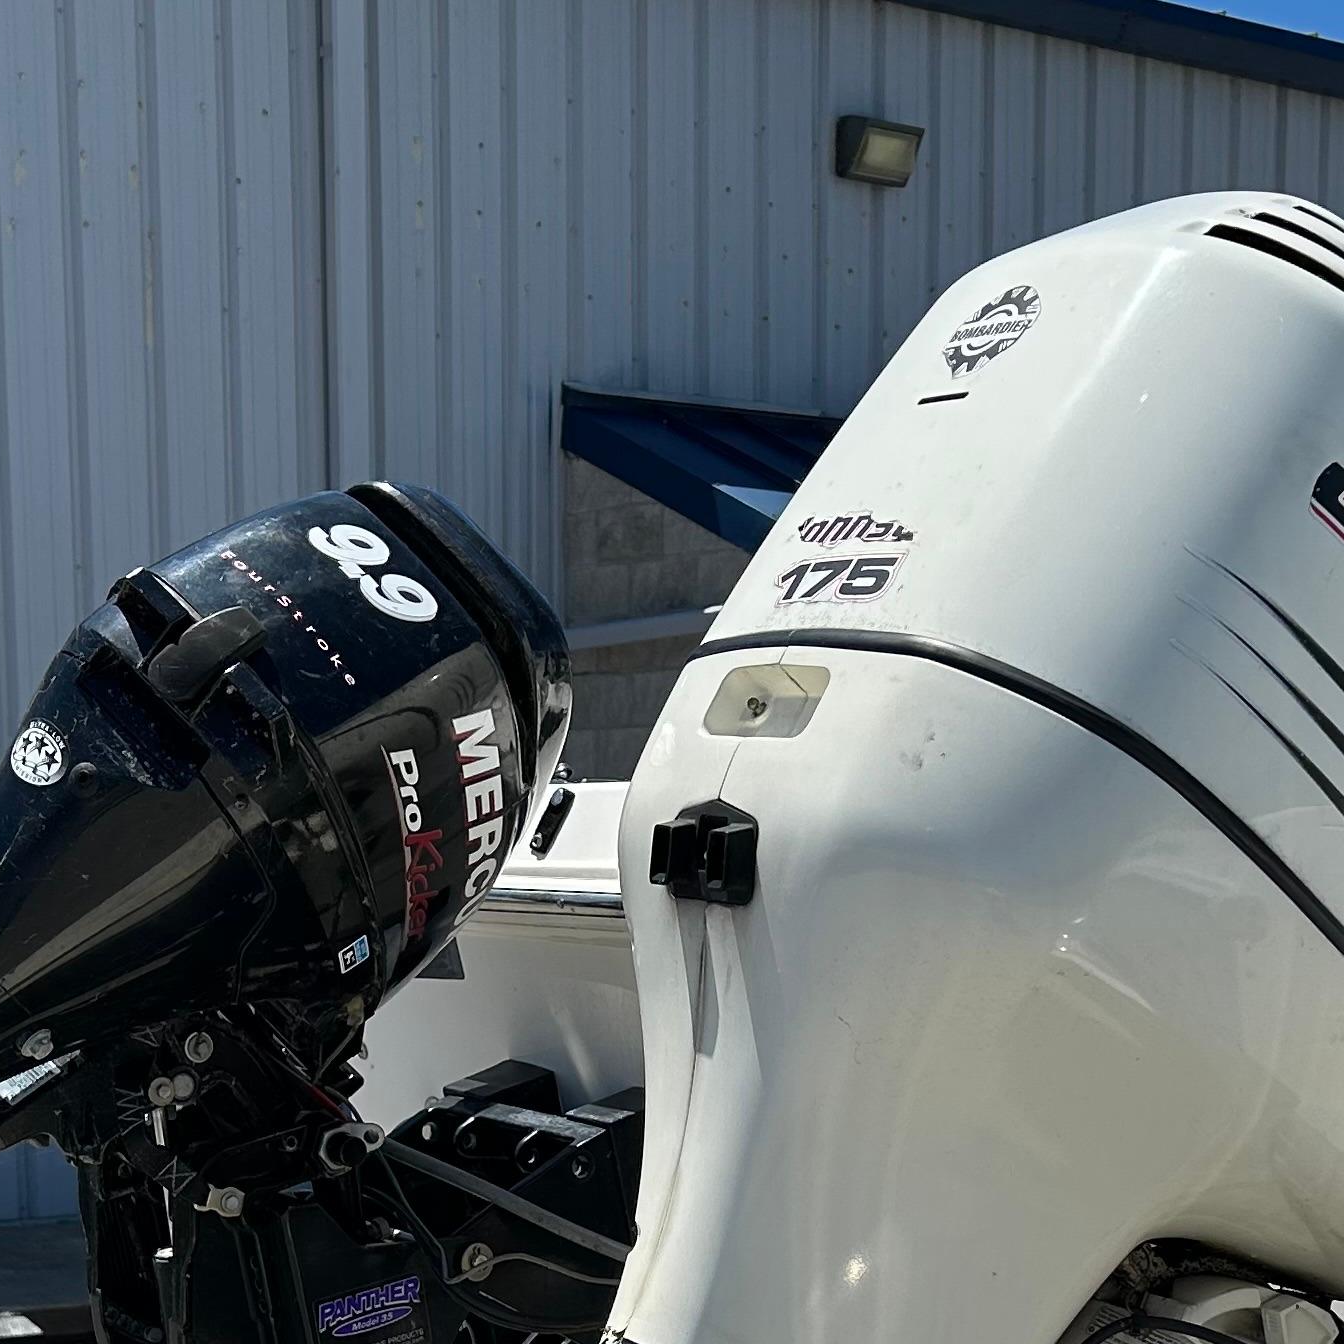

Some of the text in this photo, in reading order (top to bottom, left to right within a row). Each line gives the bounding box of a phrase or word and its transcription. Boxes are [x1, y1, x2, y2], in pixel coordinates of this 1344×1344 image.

[308, 524, 439, 622] 9.9
[779, 557, 900, 600] 175
[318, 1275, 421, 1333] PANTHER
[352, 1315, 380, 1331] Model
